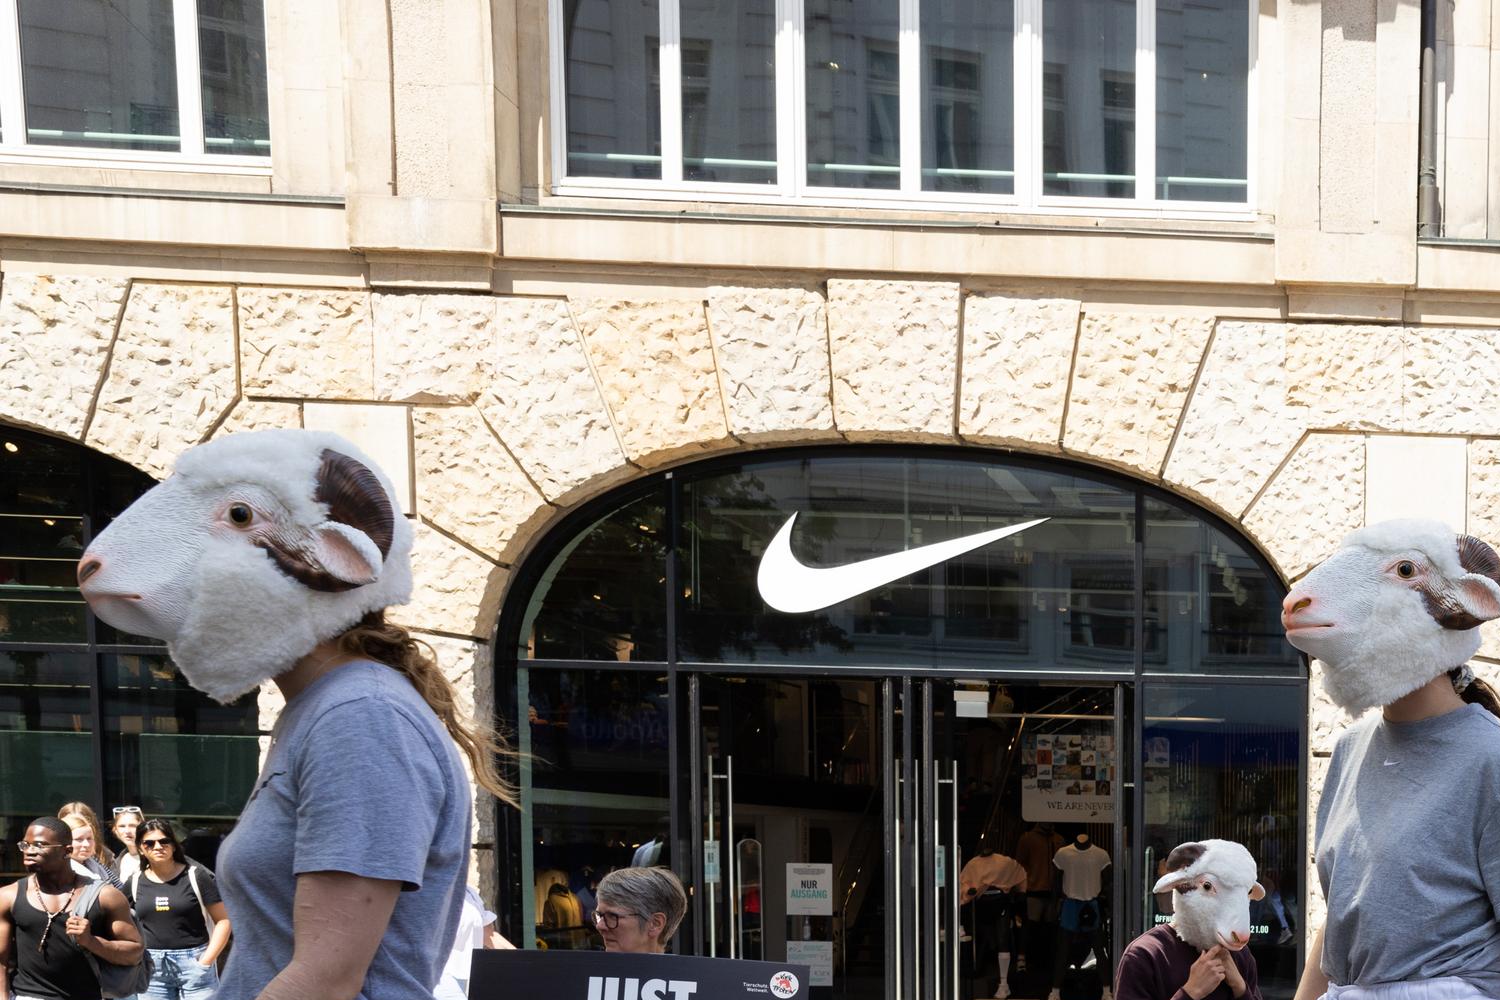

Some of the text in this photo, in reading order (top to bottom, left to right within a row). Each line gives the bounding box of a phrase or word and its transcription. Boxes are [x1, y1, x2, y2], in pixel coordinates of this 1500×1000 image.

[1047, 801, 1063, 810] WE
[801, 880, 817, 889] NUR
[791, 889, 827, 898] AUSGANG
